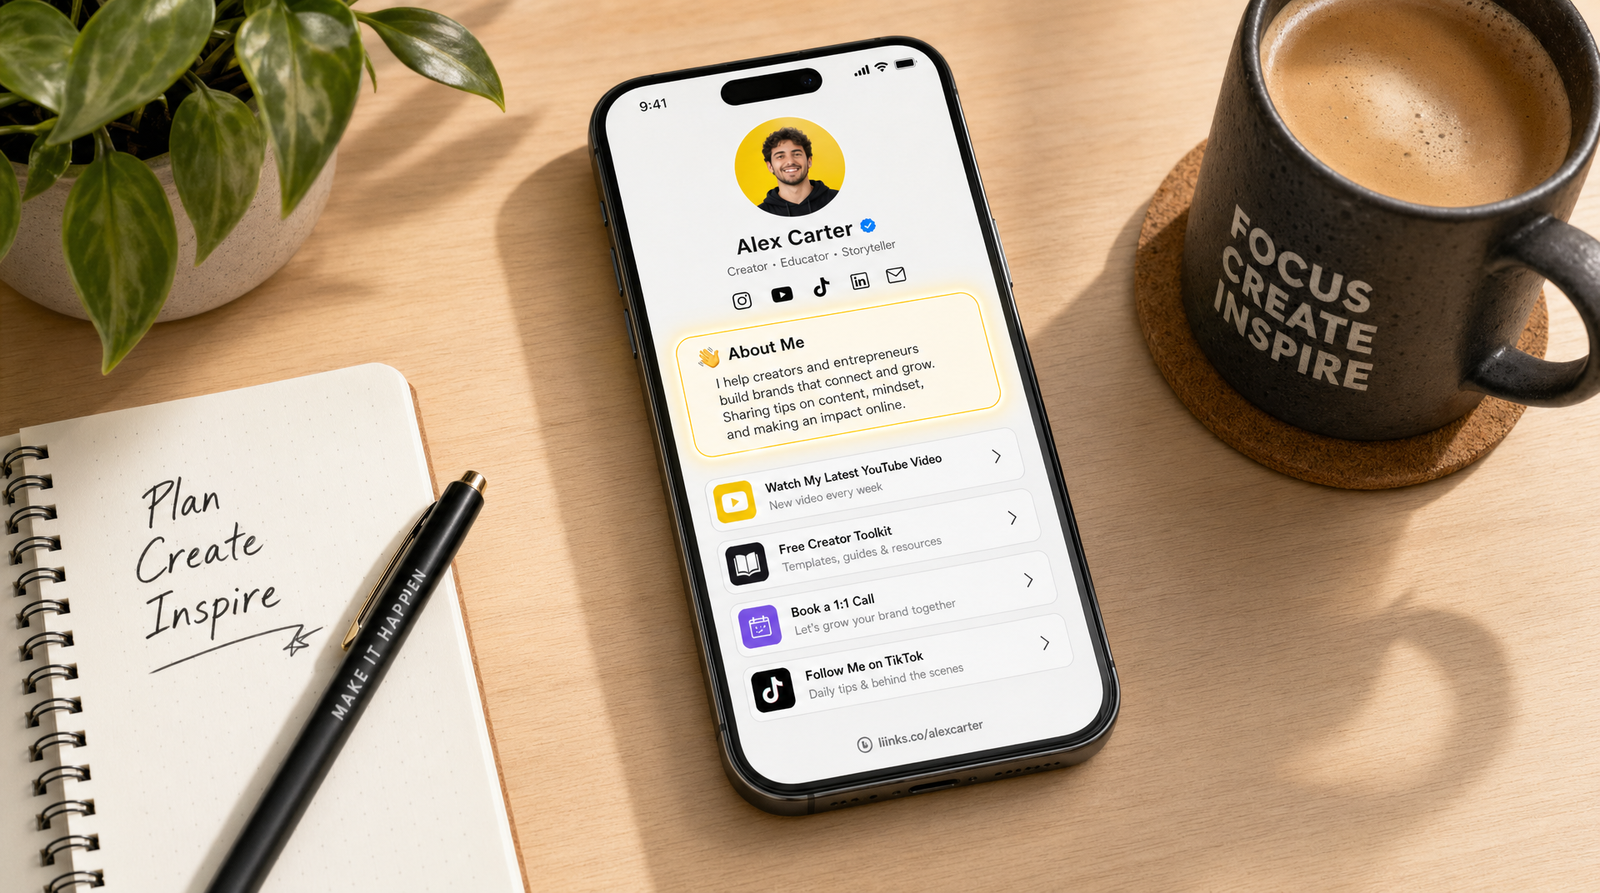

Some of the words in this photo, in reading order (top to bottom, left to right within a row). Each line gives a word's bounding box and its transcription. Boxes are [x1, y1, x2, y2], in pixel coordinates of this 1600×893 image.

[639, 98, 667, 112] 9:41
[737, 236, 783, 255] Alex
[787, 224, 853, 246] Carter
[727, 263, 768, 277] Creator
[780, 252, 829, 268] Educator
[841, 240, 896, 257] Storyteller
[1231, 204, 1373, 313] FOCUS
[1222, 245, 1378, 355] CREATE
[728, 341, 777, 361] About
[779, 336, 805, 352] Me
[1213, 278, 1374, 392] INSPIRE
[715, 378, 720, 389] I
[722, 374, 750, 388] help
[753, 366, 804, 383] creators
[806, 358, 830, 373] and
[833, 345, 919, 368] entrepreneurs
[719, 390, 750, 406] build
[752, 383, 795, 400] brands
[797, 378, 822, 392] that
[824, 369, 873, 387] connect
[876, 363, 899, 378] and
[901, 360, 935, 376] grow.
[722, 407, 771, 423] Sharing
[773, 402, 796, 416] tips
[799, 399, 815, 409] on
[818, 388, 869, 406] content,
[872, 378, 924, 396] mindset,
[727, 425, 751, 440] and
[753, 419, 799, 435] making
[802, 416, 818, 427] an
[820, 406, 863, 424] impact
[865, 401, 906, 415] online.
[764, 478, 802, 493] Watch
[803, 475, 822, 487] My
[824, 468, 860, 483] Latest
[860, 460, 909, 476] YouTube
[909, 455, 943, 467] Video
[141, 476, 220, 529] Plan
[769, 500, 793, 511] New
[795, 494, 824, 505] video
[826, 489, 853, 500] every
[856, 482, 883, 495] week
[135, 522, 264, 584] Create
[778, 543, 805, 555] Free
[807, 534, 852, 550] Creator
[853, 525, 893, 541] Toolkit
[781, 556, 840, 572] Templates,
[843, 548, 878, 564] guides
[880, 545, 889, 555] &
[892, 537, 942, 553] resources
[145, 585, 281, 640] Inspire
[790, 603, 822, 618] Book
[823, 603, 831, 612] a
[833, 598, 849, 610] 1:1
[852, 593, 875, 607] Call
[794, 623, 820, 636] Let's
[822, 619, 849, 633] grow
[852, 614, 875, 628] your
[878, 606, 909, 621] brand
[911, 600, 956, 615] together
[331, 668, 369, 721] MAKE
[363, 644, 381, 665] IT
[805, 667, 844, 681] Follow
[846, 661, 866, 674] Me
[868, 660, 883, 670] on
[884, 650, 924, 667] TikTok
[808, 686, 835, 699] Daily
[838, 683, 858, 695] tips
[860, 679, 869, 690] &
[871, 672, 907, 688] behind
[909, 670, 927, 681] the
[929, 664, 964, 678] scenes
[878, 721, 983, 748] liinks.co/alexcarter
